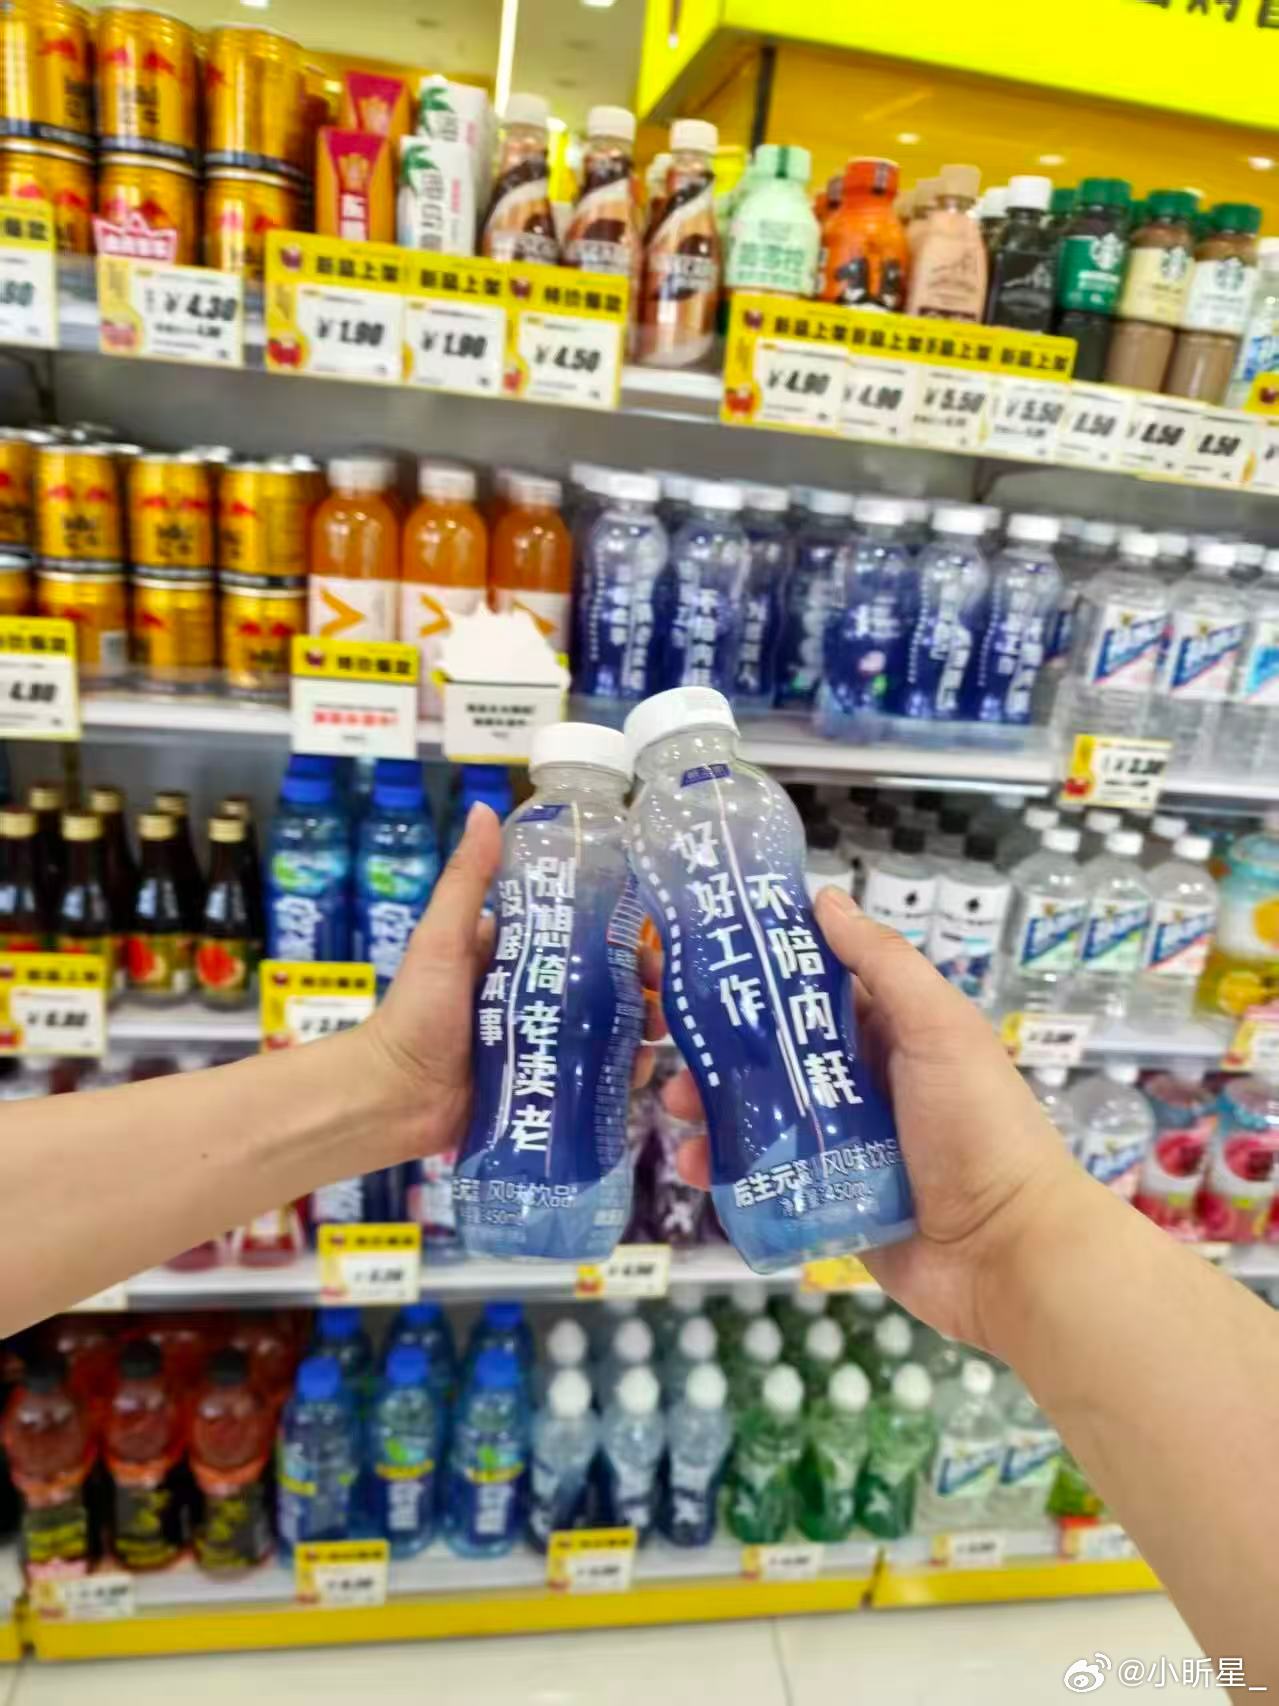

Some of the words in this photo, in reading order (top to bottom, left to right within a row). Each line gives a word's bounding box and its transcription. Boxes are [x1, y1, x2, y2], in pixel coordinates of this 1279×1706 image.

[510, 857, 576, 1152] 别想倚老卖老
[670, 821, 765, 1029] 好好工作
[745, 873, 864, 1108] 不陪内耗
[489, 1179, 577, 1208] 风味饮品
